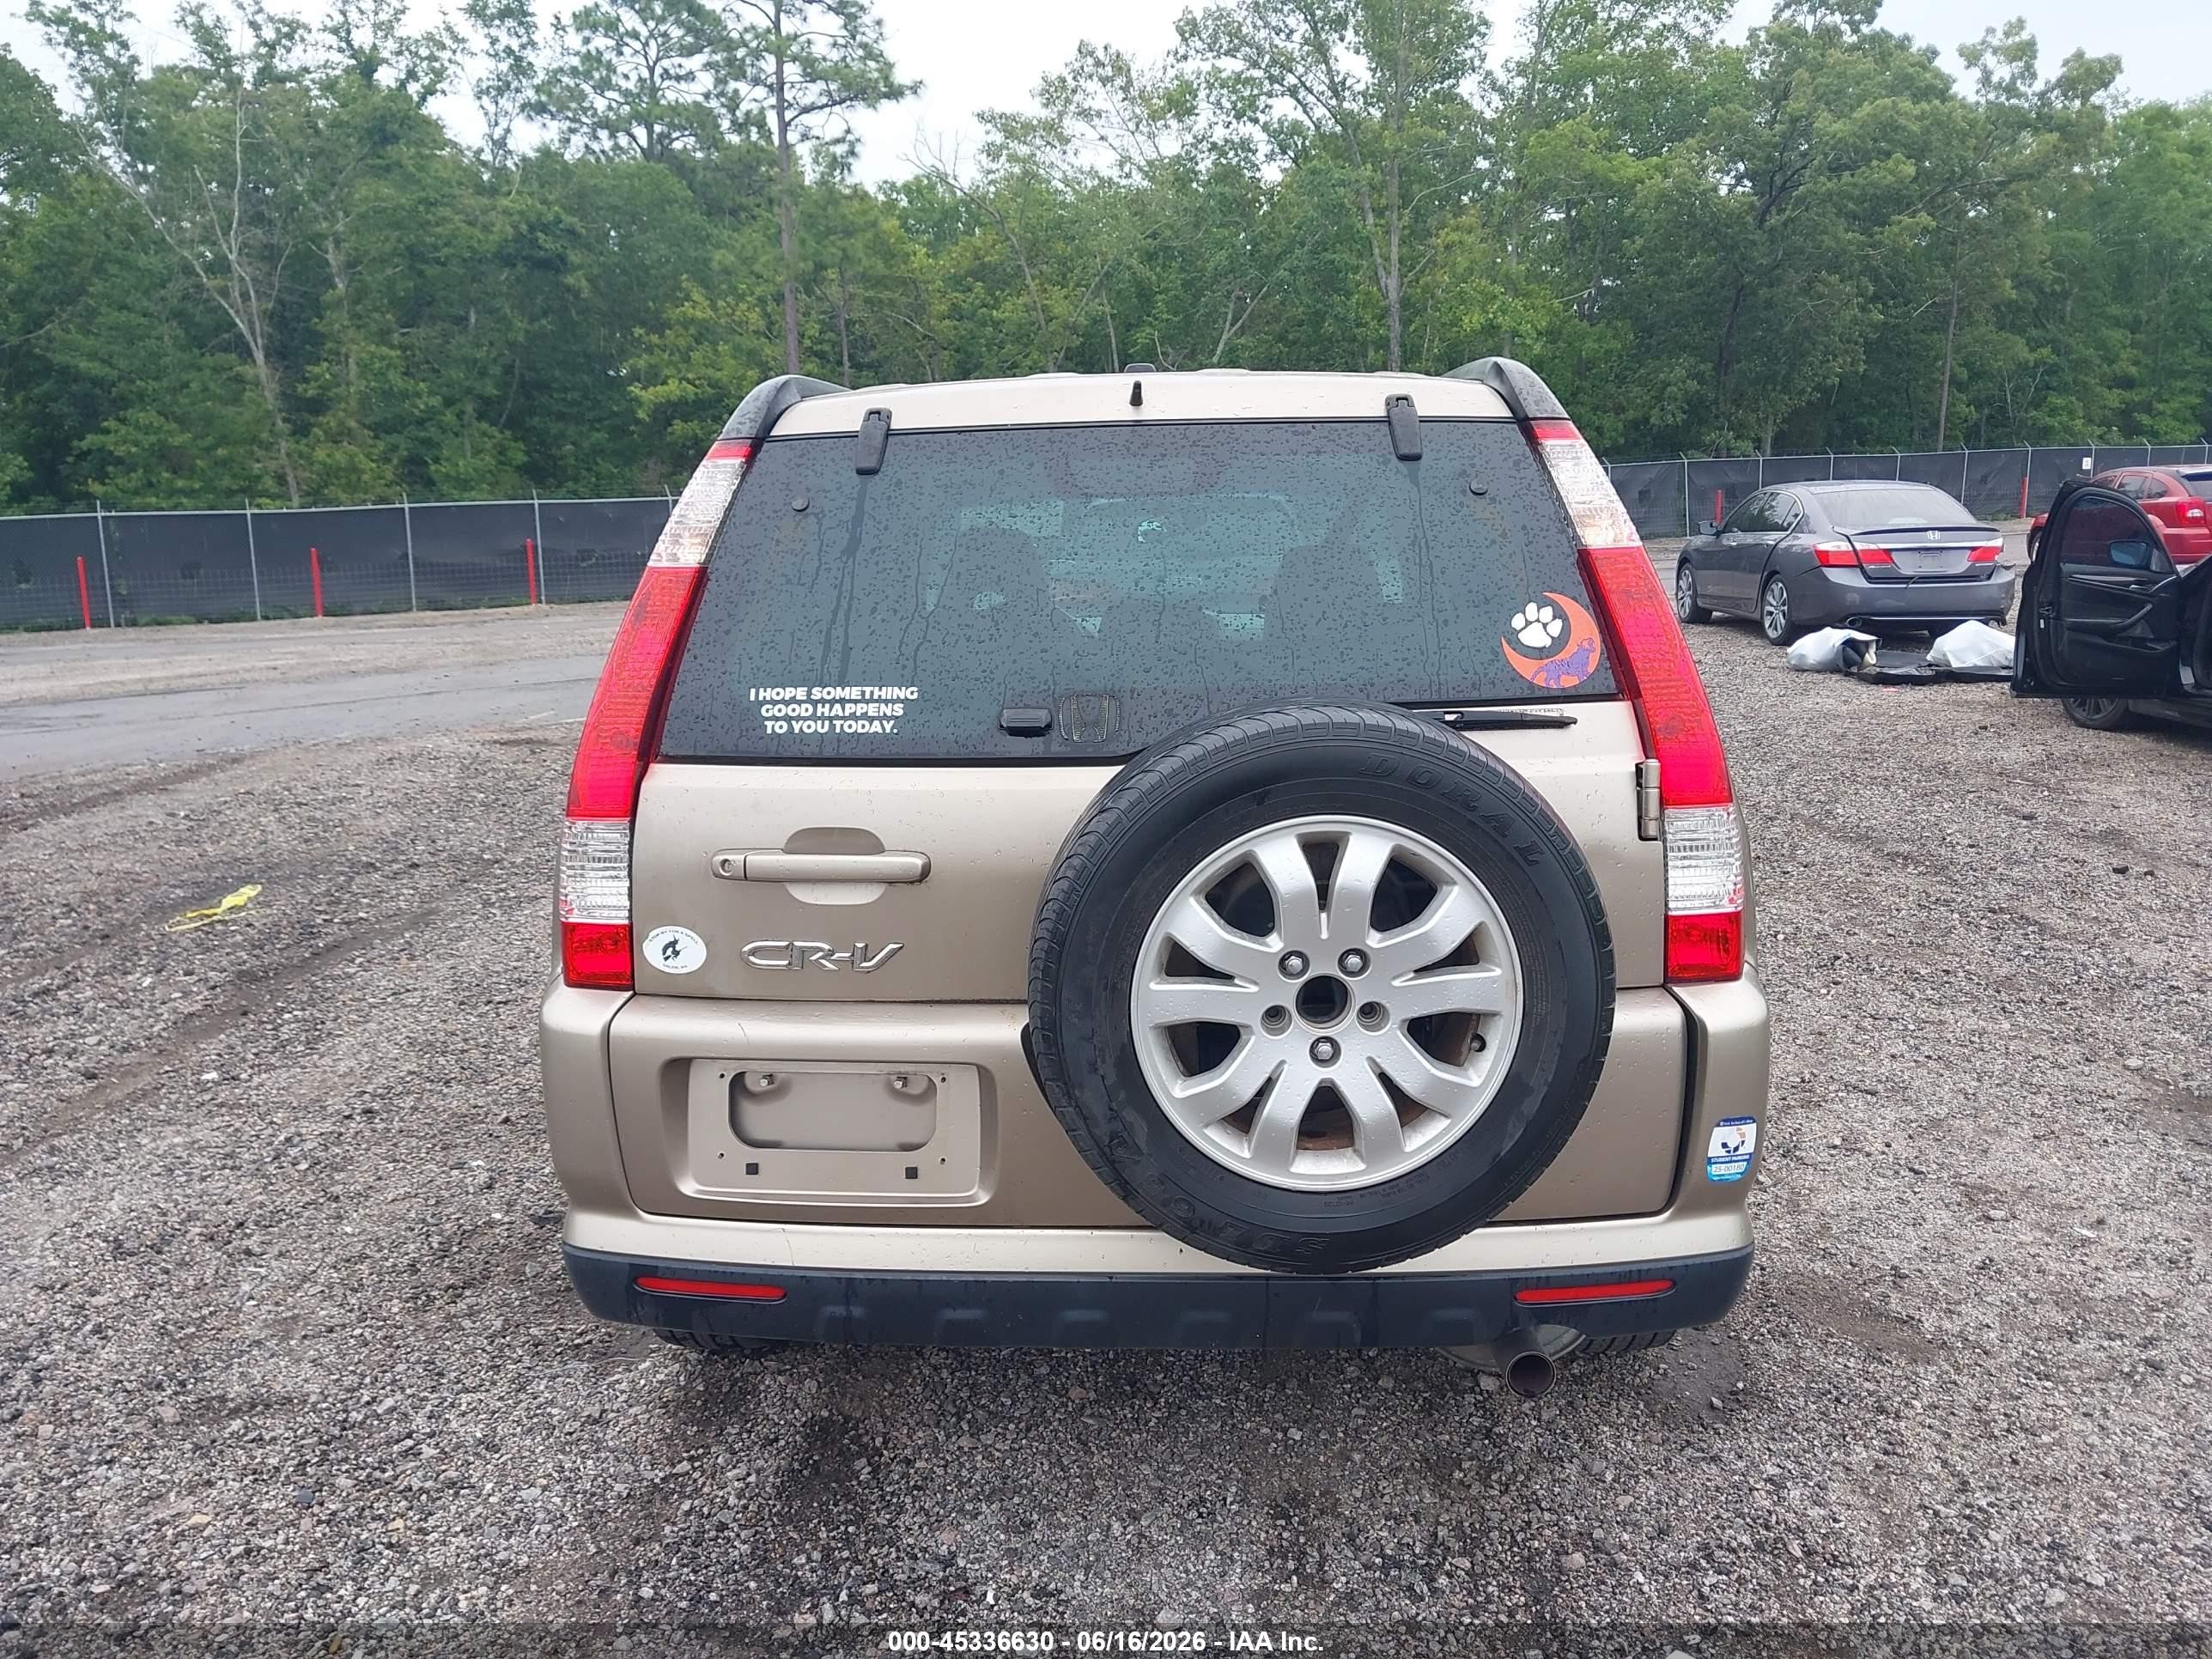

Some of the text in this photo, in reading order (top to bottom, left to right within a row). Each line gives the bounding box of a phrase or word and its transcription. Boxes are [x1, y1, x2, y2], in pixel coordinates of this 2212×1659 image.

[749, 686, 919, 702] I HOPE SOMETHING
[761, 702, 904, 717] GOOD HAPPENS
[764, 720, 898, 734] TO YOU TODAY.
[1359, 752, 1546, 867] DORAL
[740, 940, 905, 974] CR-V
